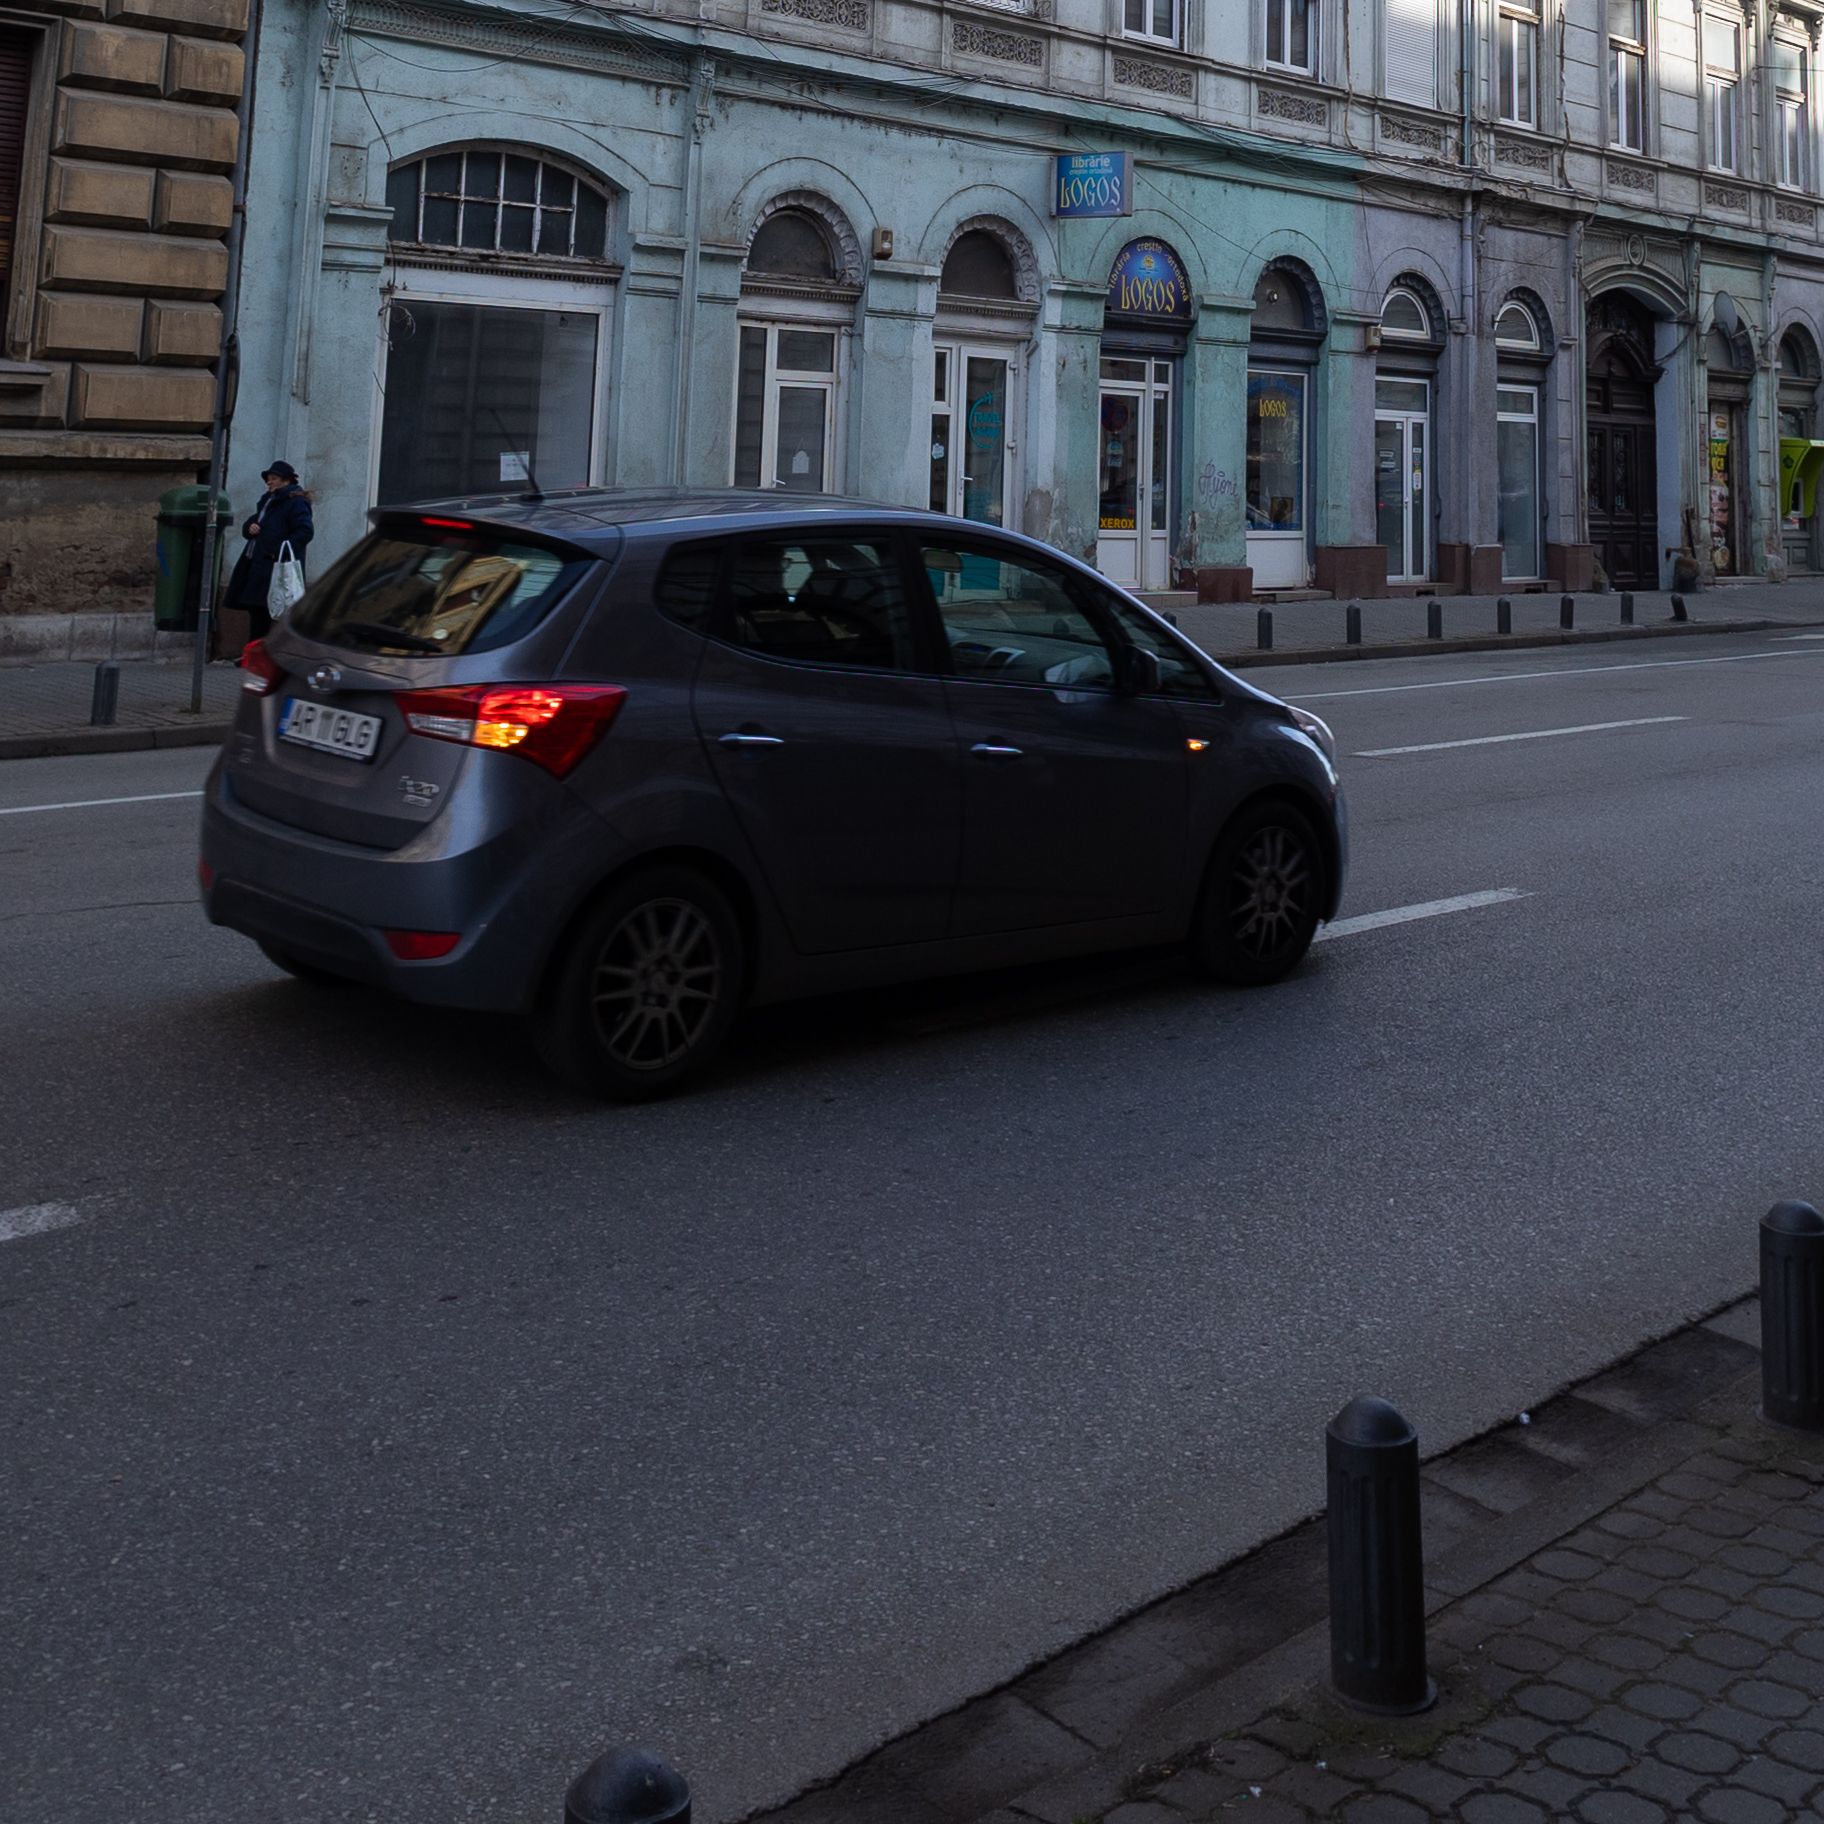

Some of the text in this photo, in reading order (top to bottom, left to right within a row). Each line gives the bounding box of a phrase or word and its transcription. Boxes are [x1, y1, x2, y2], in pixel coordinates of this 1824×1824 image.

[1060, 176, 1120, 208] LOGOS
[1121, 275, 1175, 313] LOGOS
[1259, 399, 1287, 417] LOGOS
[1100, 517, 1135, 529] XEROX
